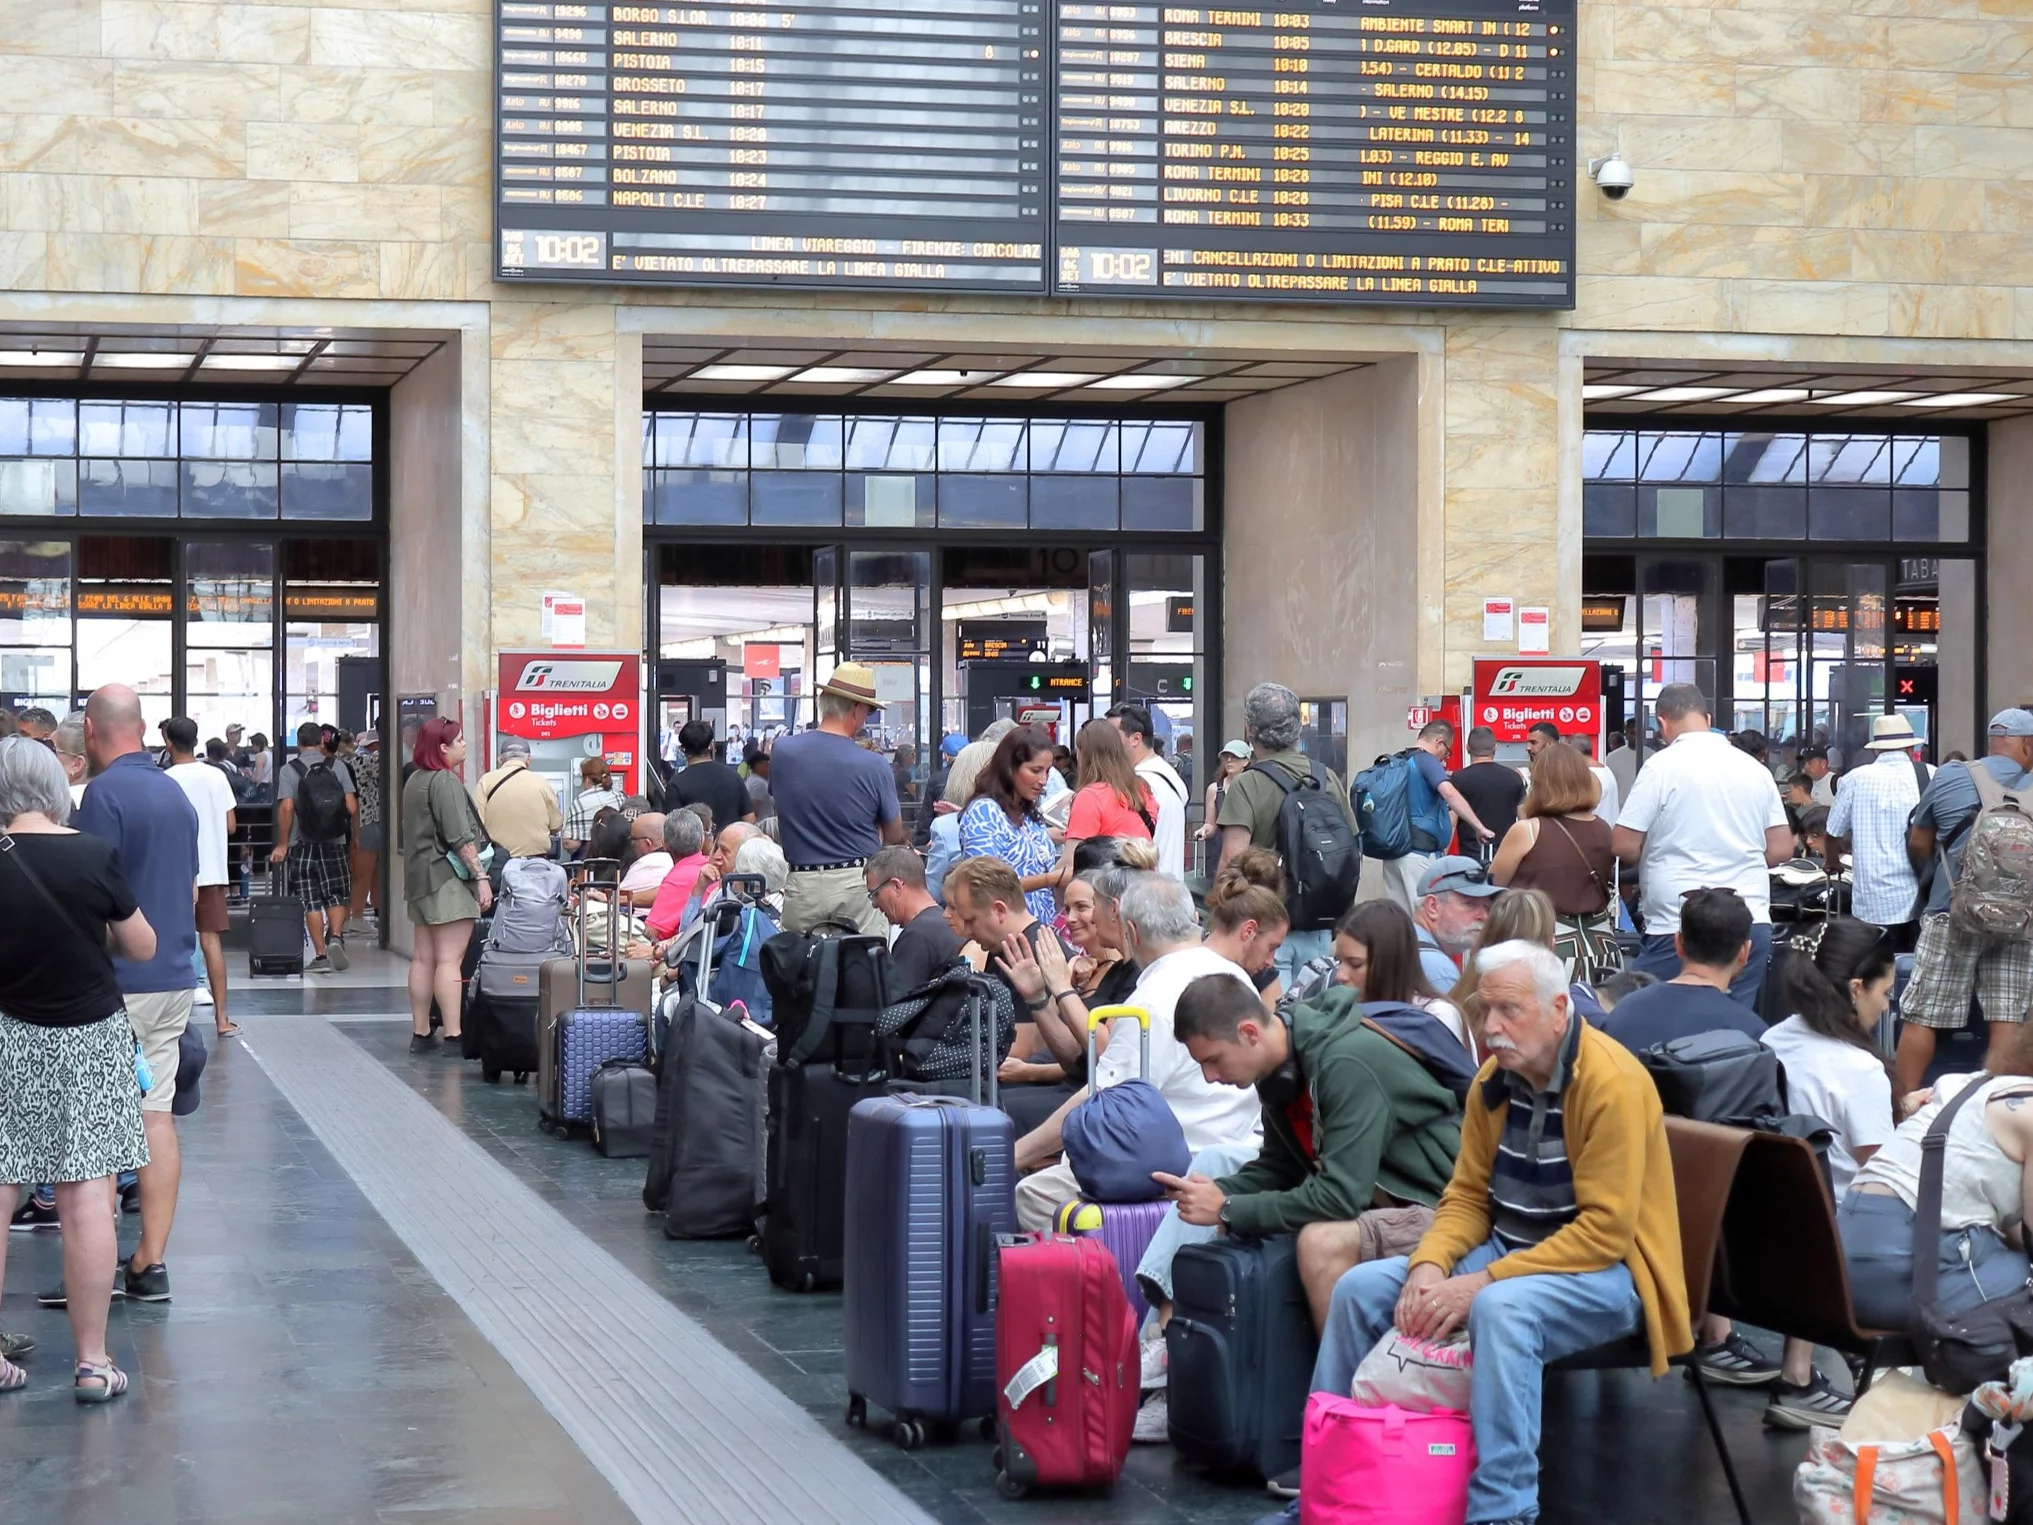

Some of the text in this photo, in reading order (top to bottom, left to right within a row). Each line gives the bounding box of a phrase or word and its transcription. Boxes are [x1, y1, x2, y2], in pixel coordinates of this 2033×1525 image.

[613, 7, 659, 23] BORGO
[1164, 9, 1199, 24] ROMA
[1208, 10, 1261, 26] TERMINI
[1274, 13, 1310, 28] 10:03
[1360, 18, 1424, 32] AMBIENTE
[1433, 20, 1473, 33] SMART
[1482, 21, 1496, 36] IN
[1515, 23, 1530, 37] 12
[613, 32, 677, 47] SALERNO
[730, 36, 762, 50] 10:11
[1164, 32, 1222, 47] BRESCIA
[1274, 36, 1310, 50] 10:05
[1515, 45, 1528, 59] 11
[613, 54, 765, 73] PISTOIA 10:15
[1164, 54, 1205, 69] SIENA
[1274, 58, 1308, 72] 10:10
[1415, 64, 1482, 78] CERTALDO
[1515, 68, 1524, 80] 2
[613, 77, 764, 96] GROSSETO 10:17
[1164, 76, 1225, 92] SALERNO
[1274, 80, 1308, 94] 10:14
[1375, 84, 1433, 99] SALERNO
[613, 100, 677, 115] SALERNO
[730, 105, 764, 119] 10:17
[1164, 98, 1222, 113] VENEZIA
[1230, 100, 1254, 115] S.L.
[1273, 102, 1309, 117] 10:20
[1389, 106, 1407, 119] VE
[1414, 107, 1463, 122] MESTRE
[1515, 111, 1523, 124] 8
[613, 123, 673, 139] VENEZIA
[730, 127, 767, 141] 10:20
[1164, 121, 1216, 135] AREZZO
[1273, 124, 1309, 139] 10:22
[1370, 127, 1434, 142] LATERINA
[1514, 132, 1530, 146] 14
[613, 145, 670, 161] PISTOIA
[730, 150, 767, 164] 10:23
[1164, 143, 1212, 158] TORINO
[1273, 147, 1310, 161] 10:25
[1415, 151, 1463, 166] REGGIO
[1471, 153, 1484, 167] E.
[1491, 154, 1509, 168] AV
[613, 168, 677, 184] BOLZANO
[730, 173, 766, 187] 10:24
[1164, 165, 1199, 180] ROMA
[1208, 166, 1261, 182] TERMINI
[1273, 169, 1309, 183] 10:28
[1362, 172, 1382, 185] INI
[613, 191, 665, 206] NAPOLI
[730, 196, 766, 209] 10:27
[1164, 188, 1221, 202] LIVORNO
[1273, 191, 1309, 205] 10:28
[1371, 195, 1402, 208] PISA
[1164, 210, 1199, 225] ROMA
[1209, 211, 1261, 226] TERMINI
[1273, 213, 1309, 228] 10:33
[1439, 217, 1473, 232] ROMA
[535, 235, 599, 263] 10:02
[751, 236, 1041, 259] LINEA VIAREGGIO FIRENZE: CIRCOLAZ
[635, 256, 693, 272] VIETATO
[703, 257, 809, 275] OLTREPASSARE
[817, 261, 835, 276] LA
[844, 262, 886, 277] LINEA
[895, 263, 944, 279] GIALLA
[1091, 252, 1150, 280] 10:02
[1193, 252, 1298, 267] CANCELLAZIONI
[1305, 254, 1315, 268] O
[1323, 255, 1404, 272] LIMITAZIONI
[1411, 257, 1420, 270] A
[1428, 257, 1470, 272] PRATO
[1184, 273, 1240, 288] VIETATO
[1248, 274, 1348, 290] OLTREPASSARE
[1356, 277, 1374, 291] LA
[1382, 278, 1421, 292] LINEA
[1429, 279, 1477, 294] GIALLA
[354, 598, 374, 606] PRATO
[549, 680, 607, 688] TRENITALIA
[1520, 685, 1571, 693] TRENITALIA
[531, 704, 588, 718] Biglietti
[1503, 708, 1554, 722] Biglietti
[531, 719, 556, 727] Tickets
[1503, 722, 1527, 730] Tickets
